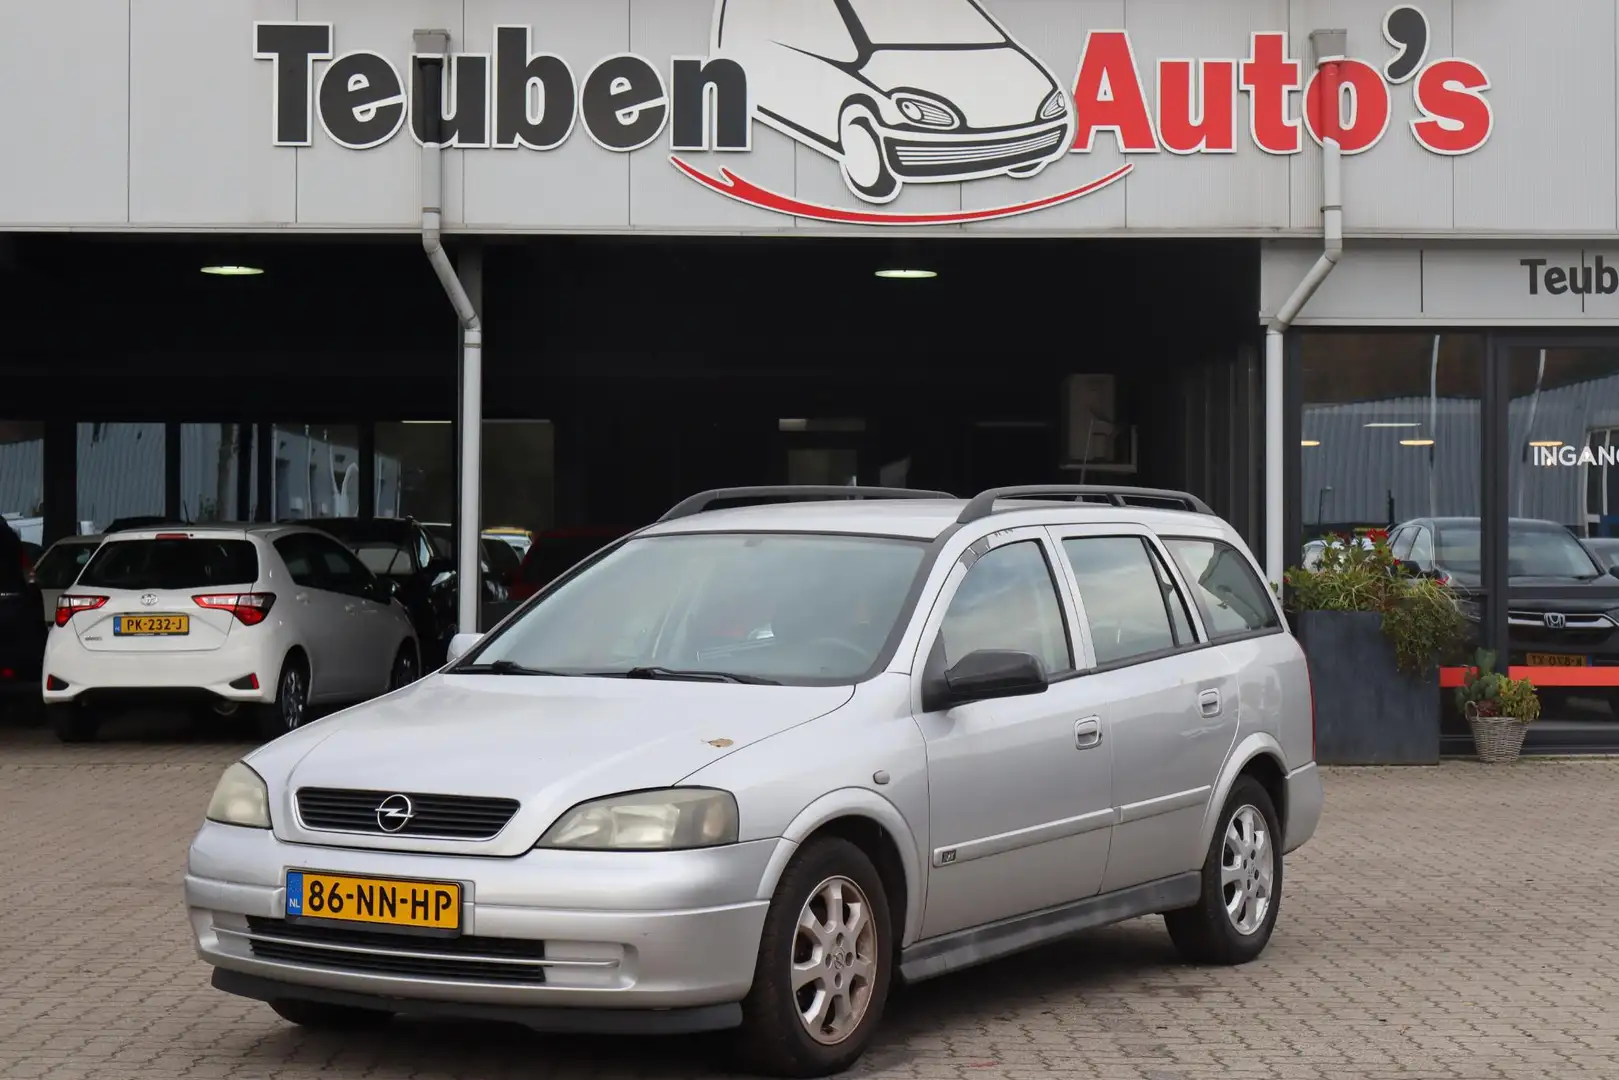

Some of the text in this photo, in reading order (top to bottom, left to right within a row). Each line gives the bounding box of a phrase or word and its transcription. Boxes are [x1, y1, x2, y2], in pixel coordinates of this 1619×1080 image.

[254, 4, 1494, 155] Teuben Auto's
[1520, 255, 1619, 295] Teub
[1533, 445, 1619, 467] INGAN
[127, 619, 182, 630] PK-232-J
[289, 880, 452, 921] NL 86-NN-HP
